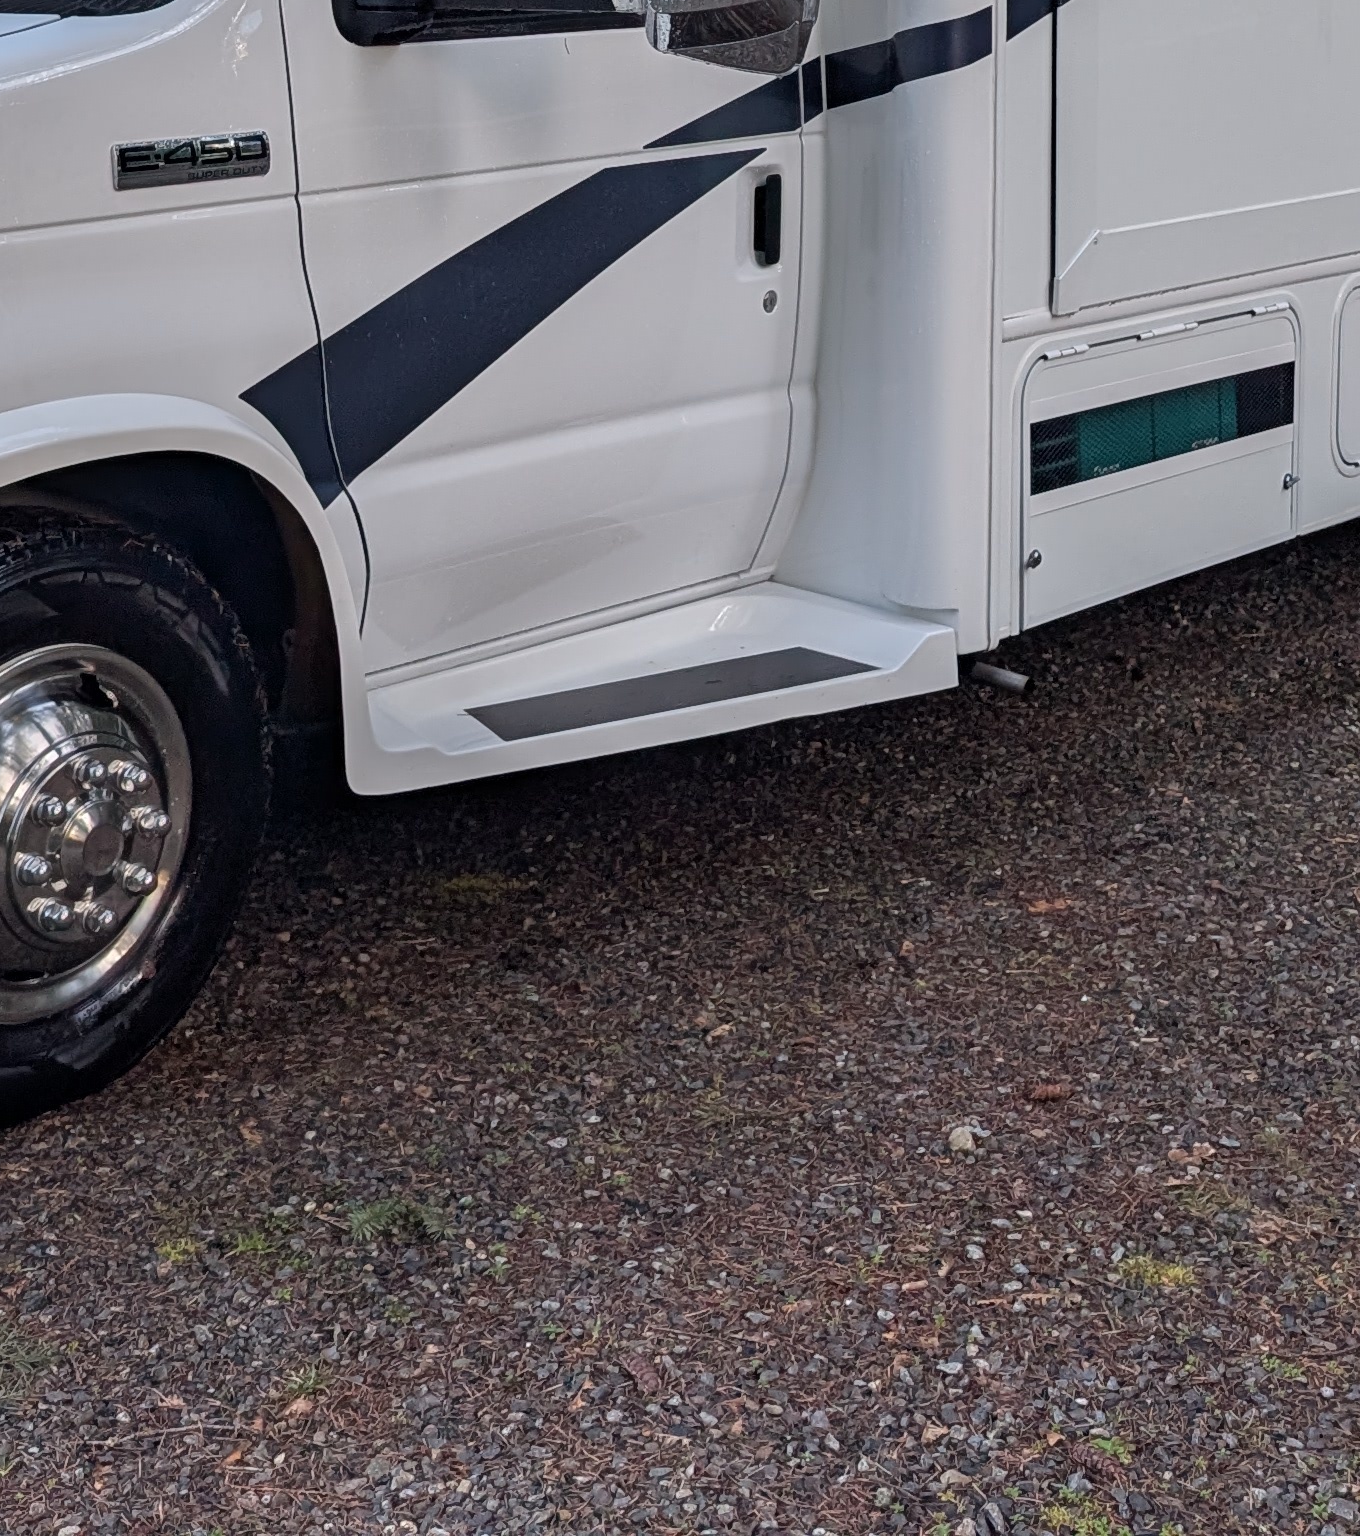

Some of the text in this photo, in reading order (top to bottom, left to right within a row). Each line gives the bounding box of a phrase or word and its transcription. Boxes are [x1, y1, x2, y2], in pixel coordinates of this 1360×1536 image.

[118, 134, 268, 173] E-450
[187, 165, 268, 181] SUPER DUTY
